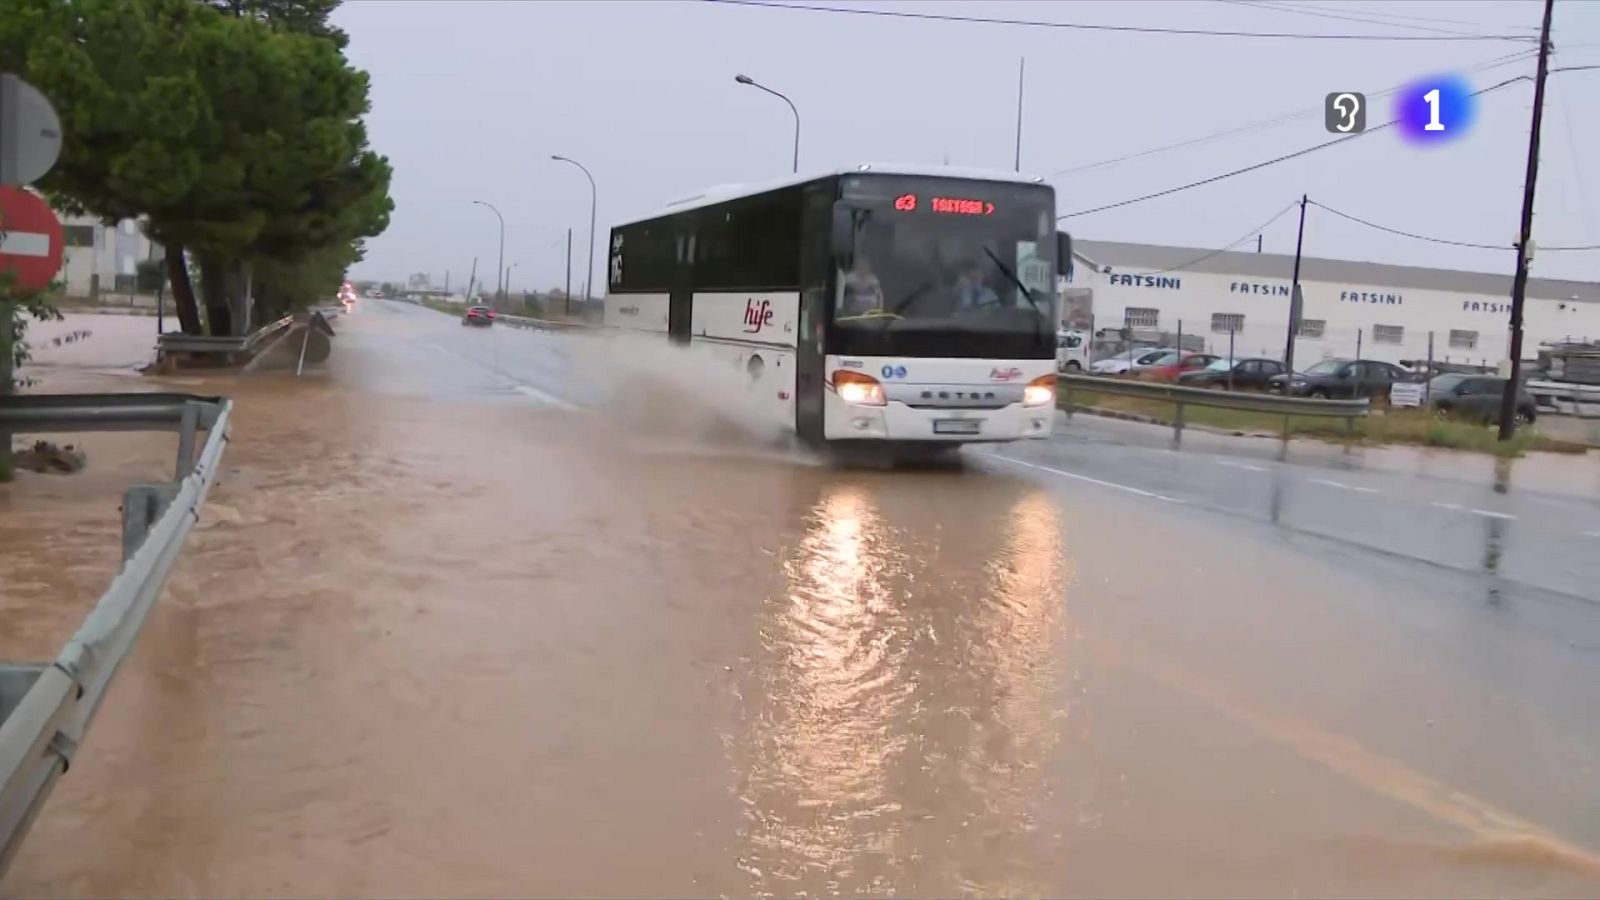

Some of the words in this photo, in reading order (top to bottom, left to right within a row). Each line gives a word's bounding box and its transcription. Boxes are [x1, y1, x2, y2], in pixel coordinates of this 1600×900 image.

[1110, 274, 1181, 289] FATSINI
[1230, 282, 1290, 297] FATSIN
[1340, 291, 1402, 305] FATSINI
[1463, 301, 1513, 313] FATSIN
[743, 298, 773, 333] hife
